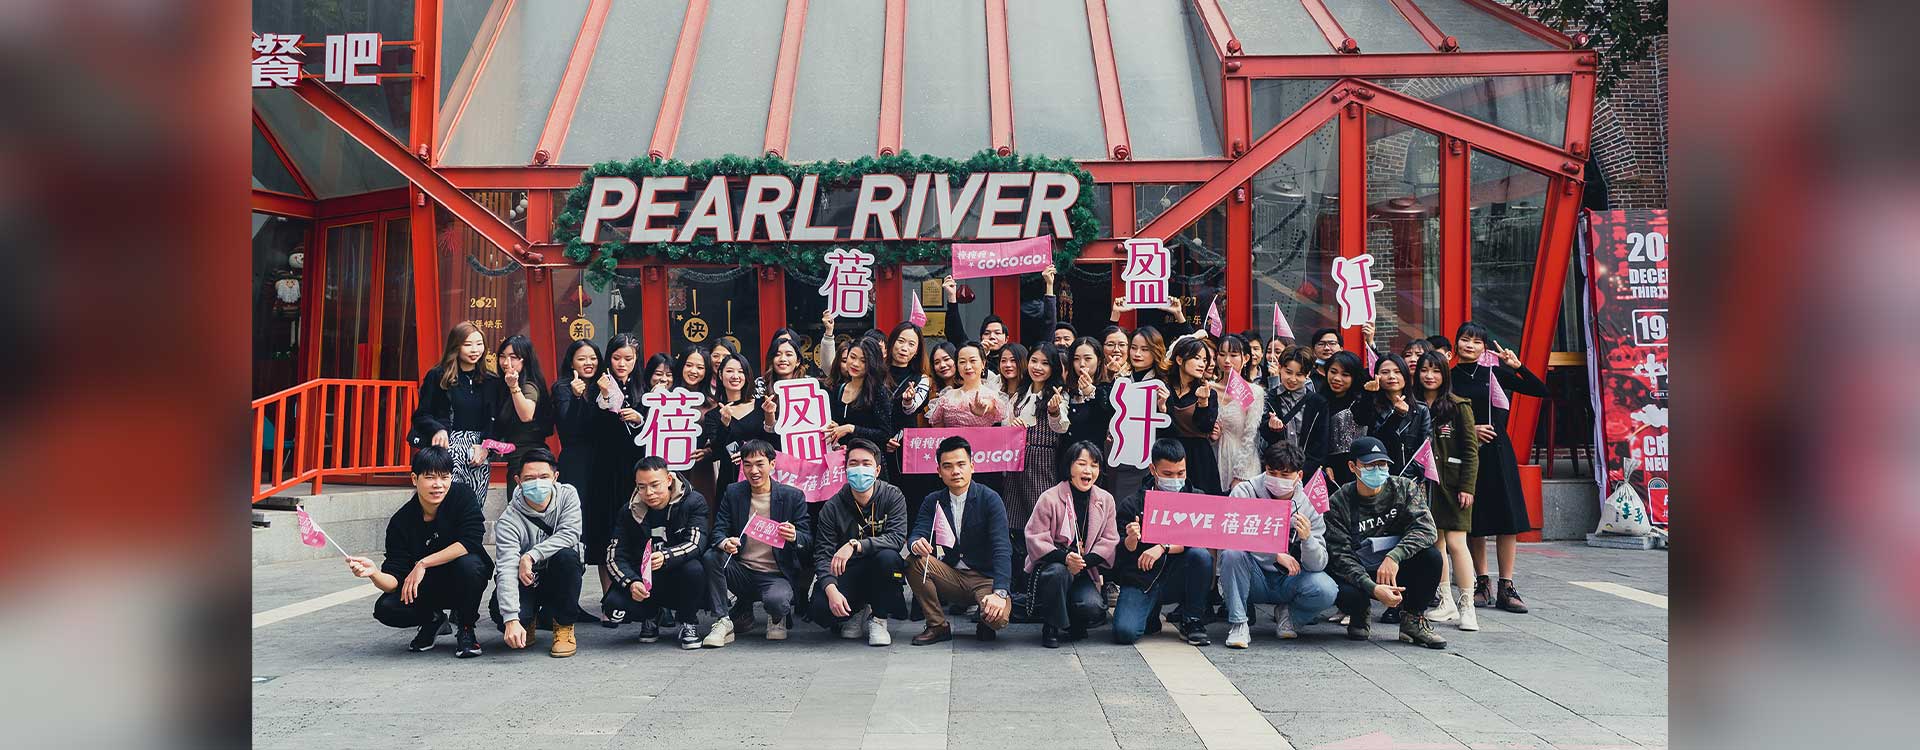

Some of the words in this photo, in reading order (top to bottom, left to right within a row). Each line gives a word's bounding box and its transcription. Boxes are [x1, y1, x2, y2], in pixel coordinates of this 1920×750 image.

[252, 32, 381, 87] 餐吧
[580, 174, 838, 243] PEARL
[850, 172, 1081, 241] RIVER
[977, 254, 1047, 270] GO!GO!GO!
[1626, 232, 1668, 262] 20
[825, 253, 870, 314] 蓓
[1126, 242, 1167, 305] 盈
[1336, 258, 1379, 325] 纤
[1629, 268, 1668, 284] DECE
[470, 319, 503, 329] 年快乐
[572, 323, 591, 338] 新
[686, 323, 706, 339] 快
[1637, 315, 1668, 340] 19
[641, 392, 699, 465] 蓓
[779, 383, 827, 461] 盈
[1113, 382, 1166, 464] 纤
[1150, 509, 1159, 524] I
[1221, 512, 1284, 537] 蓓盈纤
